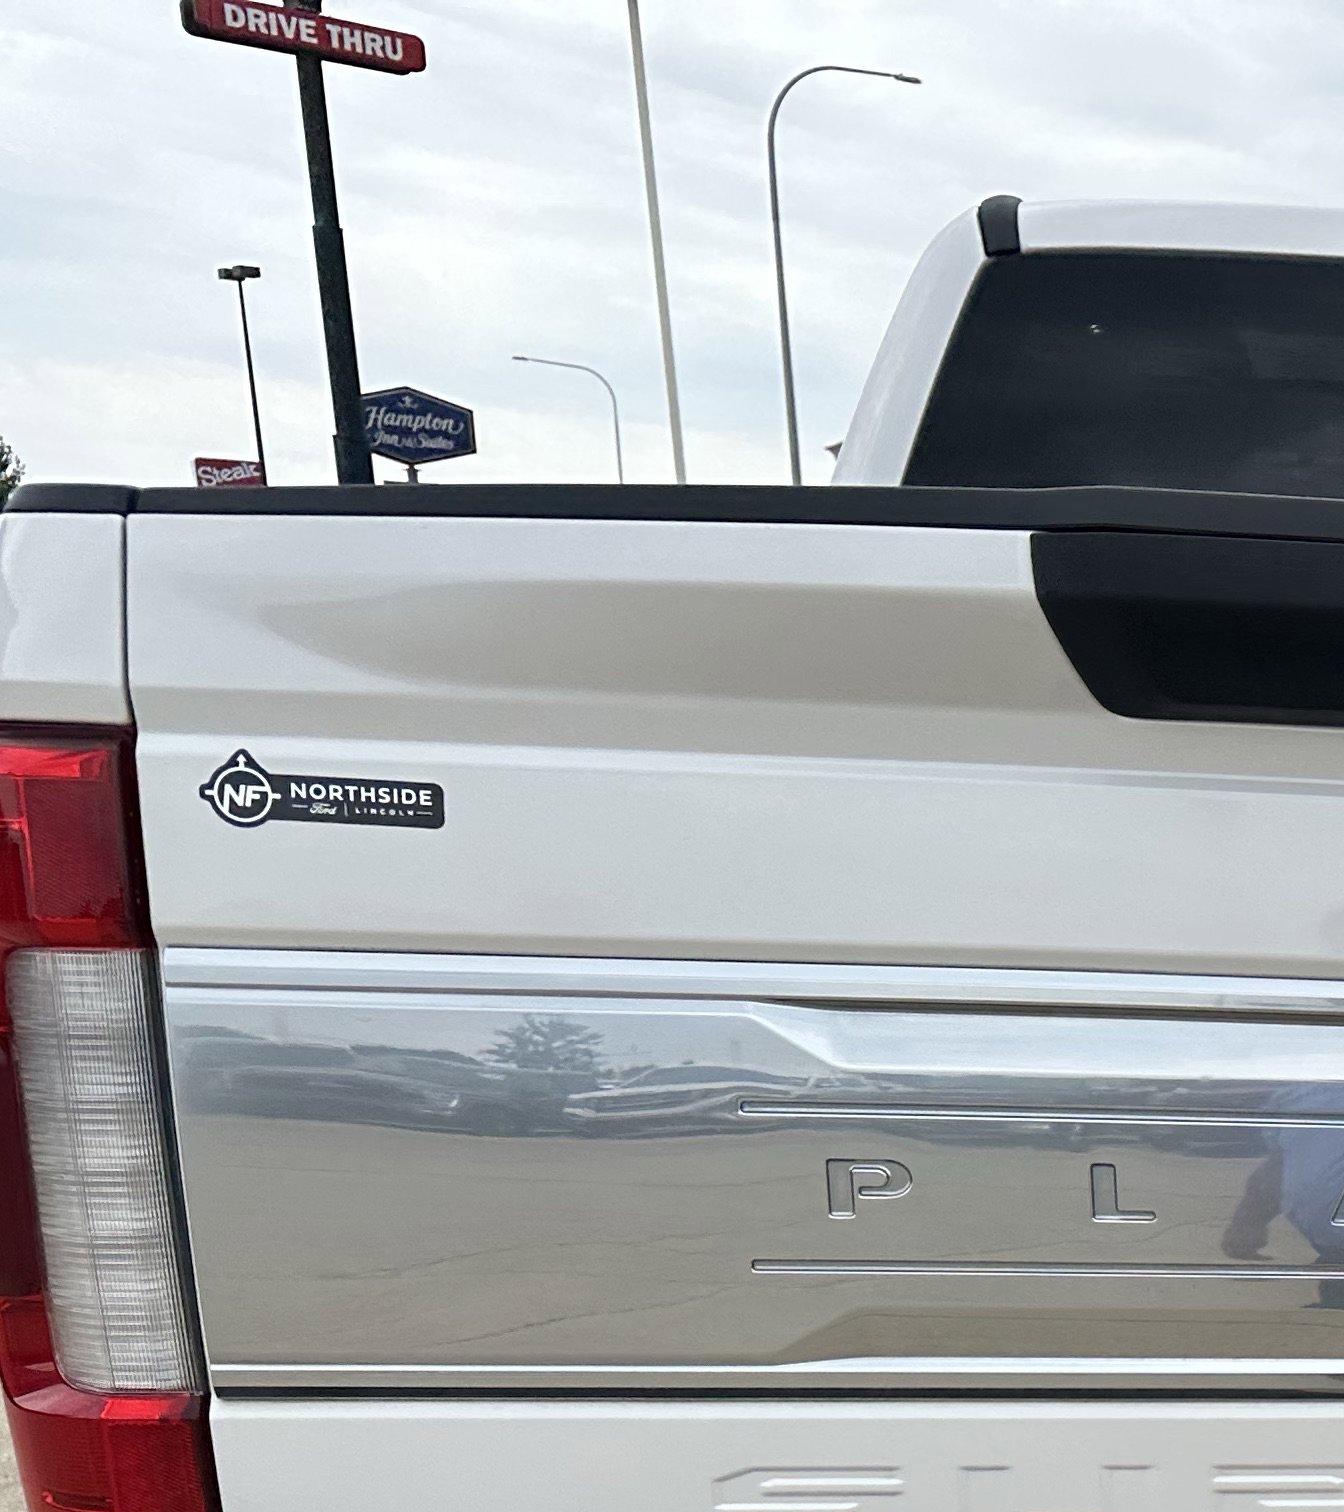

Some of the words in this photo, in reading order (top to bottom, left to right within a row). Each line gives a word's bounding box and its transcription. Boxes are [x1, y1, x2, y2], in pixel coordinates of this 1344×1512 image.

[223, 3, 319, 45] DRIVE
[325, 23, 404, 61] THRU
[365, 406, 464, 435] Hampton
[372, 430, 403, 447] Inn
[198, 462, 261, 487] Steak
[290, 783, 432, 806] NORTHSIDE
[309, 803, 337, 815] Ford
[355, 807, 414, 816] LINCOLN
